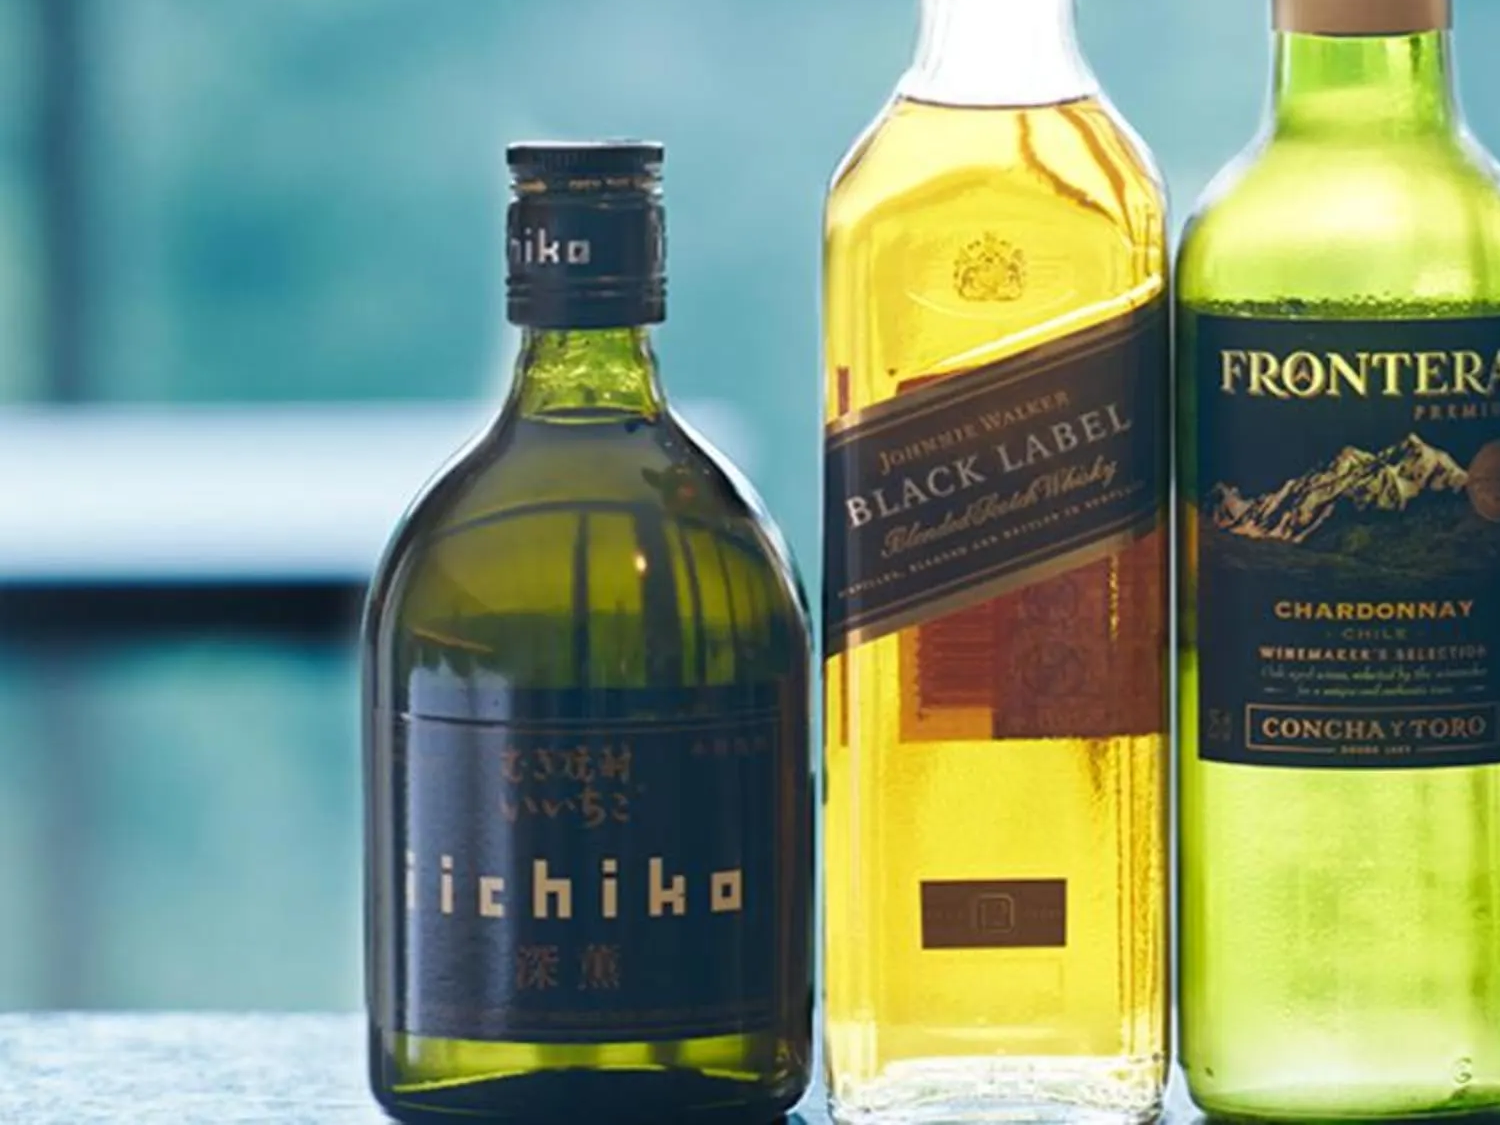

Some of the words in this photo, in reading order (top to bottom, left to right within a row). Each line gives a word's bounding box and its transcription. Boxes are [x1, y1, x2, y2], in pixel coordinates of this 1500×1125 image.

[983, 390, 1071, 431] WALKER
[845, 455, 987, 528] BLACK
[996, 403, 1133, 474] LABEL
[1273, 599, 1475, 620] CHARDONNAY
[1261, 716, 1386, 741] CONCHA
[1388, 719, 1405, 738] Y
[1405, 714, 1487, 739] TORO
[405, 850, 743, 919] iichiko
